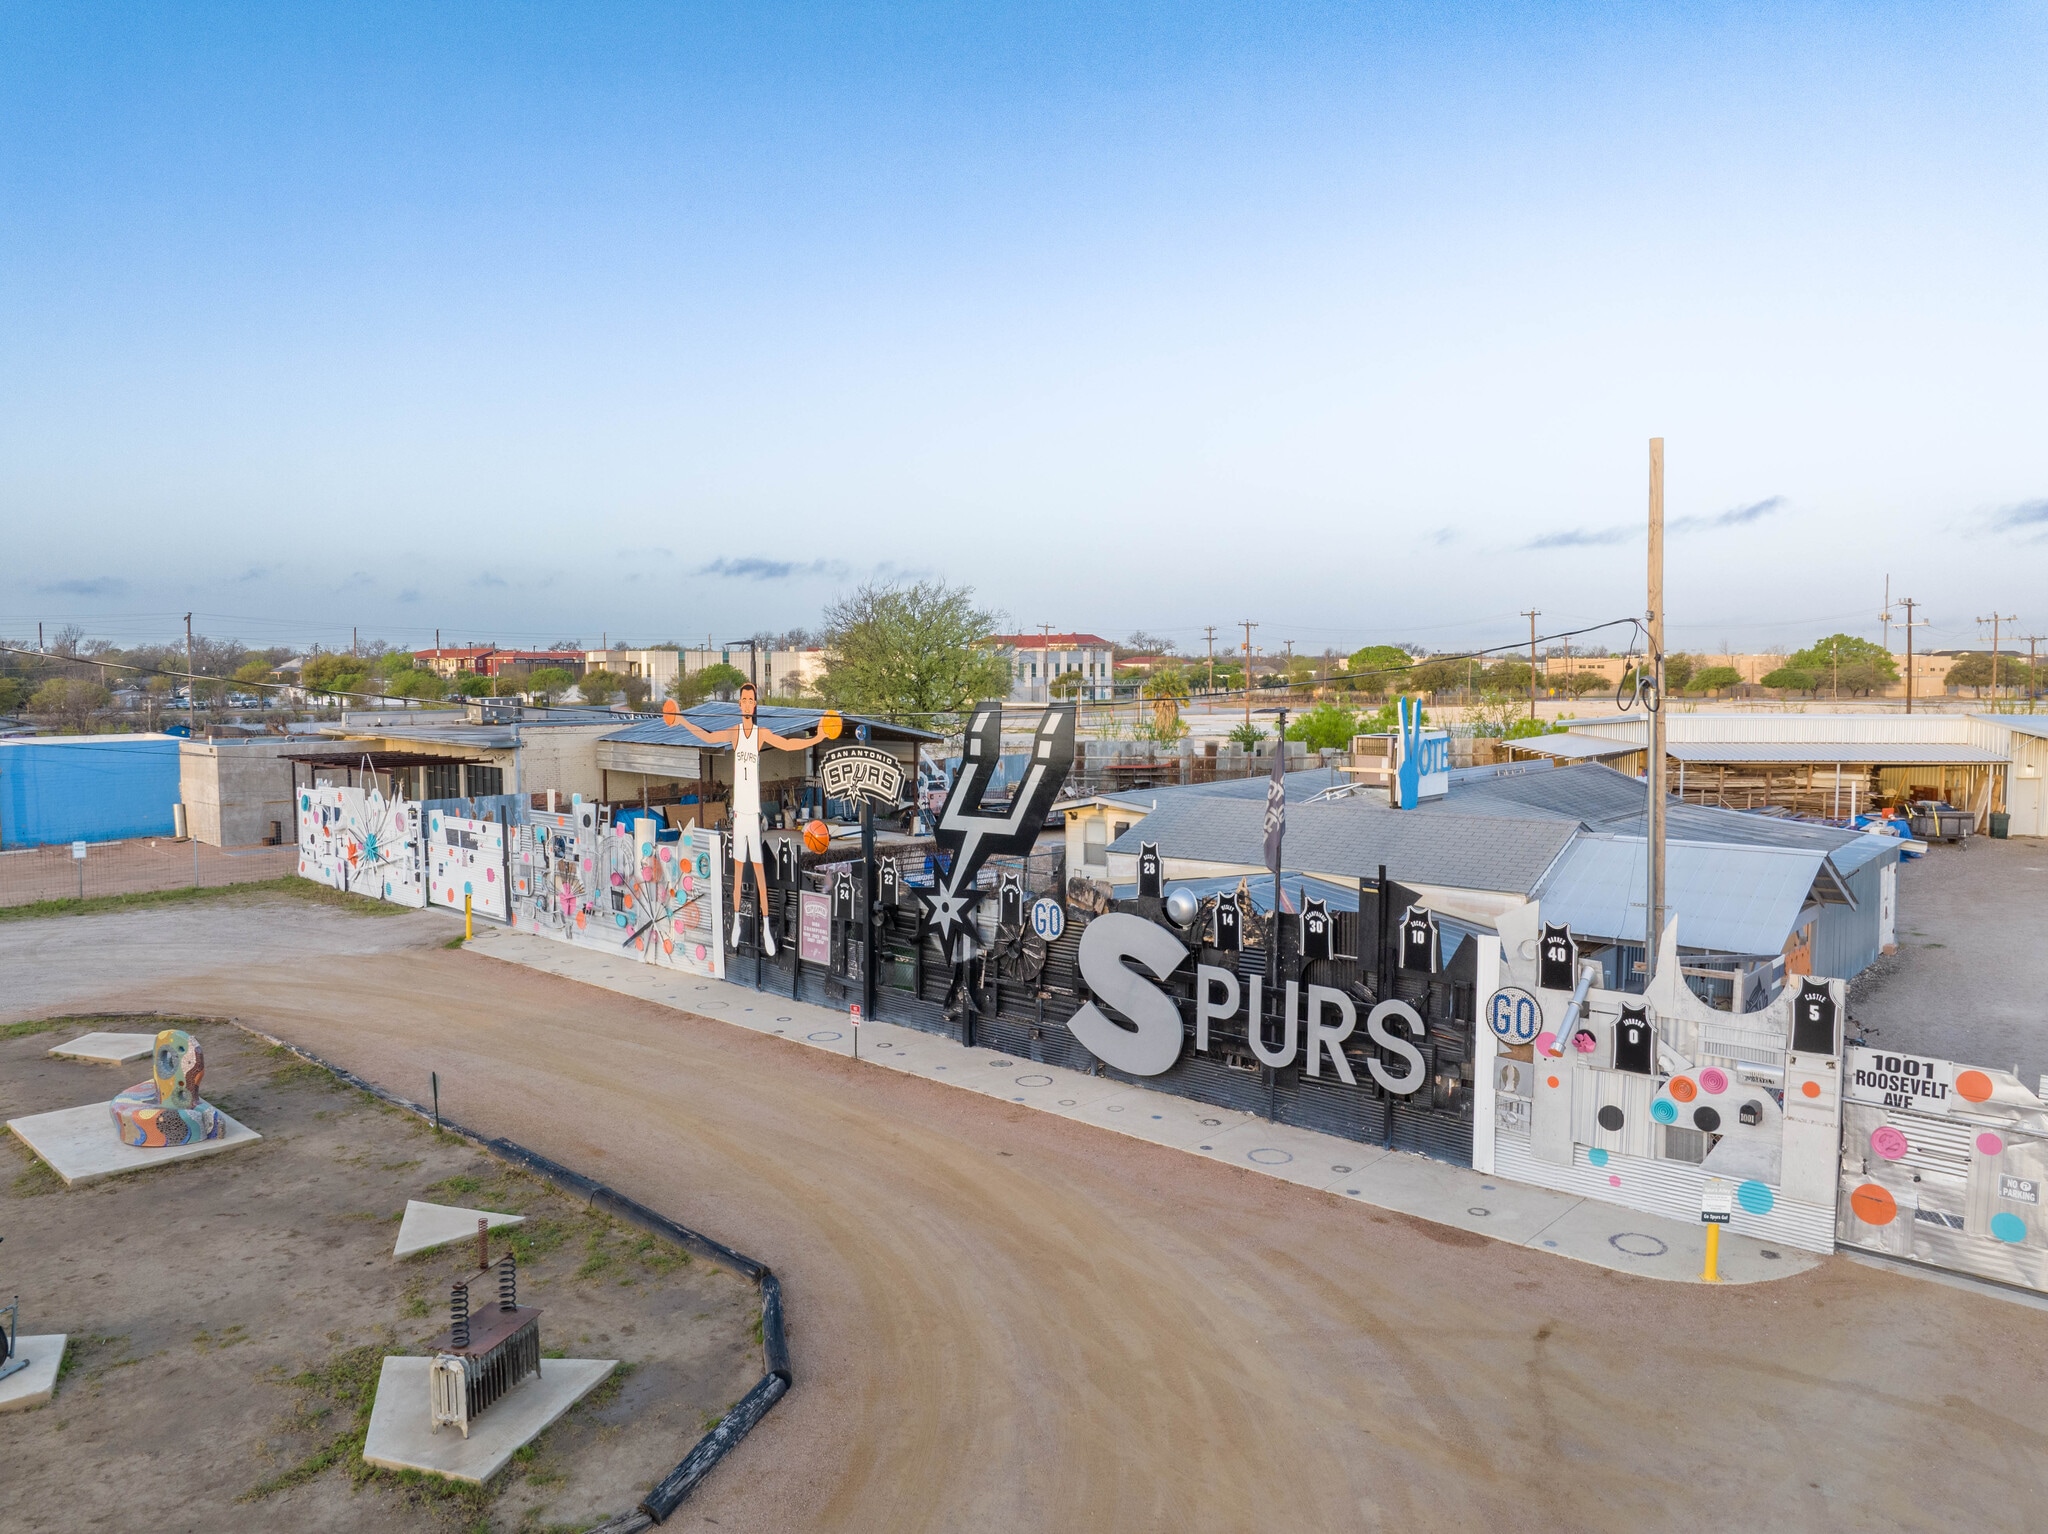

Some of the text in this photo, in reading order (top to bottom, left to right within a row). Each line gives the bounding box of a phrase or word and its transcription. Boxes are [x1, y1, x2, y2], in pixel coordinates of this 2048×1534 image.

[737, 751, 757, 763] SPURS
[831, 750, 892, 765] SAN ANTONIO
[744, 767, 748, 780] 1
[829, 763, 895, 791] SPURS
[782, 853, 788, 863] 4
[1143, 862, 1155, 875] 28
[884, 874, 893, 885] 22
[840, 889, 849, 900] 24
[1009, 892, 1013, 903] 1
[1035, 903, 1060, 935] GO
[1222, 913, 1233, 926] 14
[1309, 919, 1323, 933] 30
[1412, 930, 1425, 944] 10
[1548, 946, 1566, 962] 40
[1067, 912, 1426, 1095] SPURS
[1804, 992, 1827, 1004] CASTLE
[1493, 994, 1535, 1039] GO
[1809, 1004, 1820, 1021] 5
[1629, 1028, 1639, 1044] 0
[1872, 1054, 1934, 1079] 1001
[1855, 1069, 1949, 1100] ROOSEVELT
[1740, 1113, 1754, 1124] 1001
[2007, 1178, 2018, 1189] NO
[2002, 1187, 2036, 1202] PARKING
